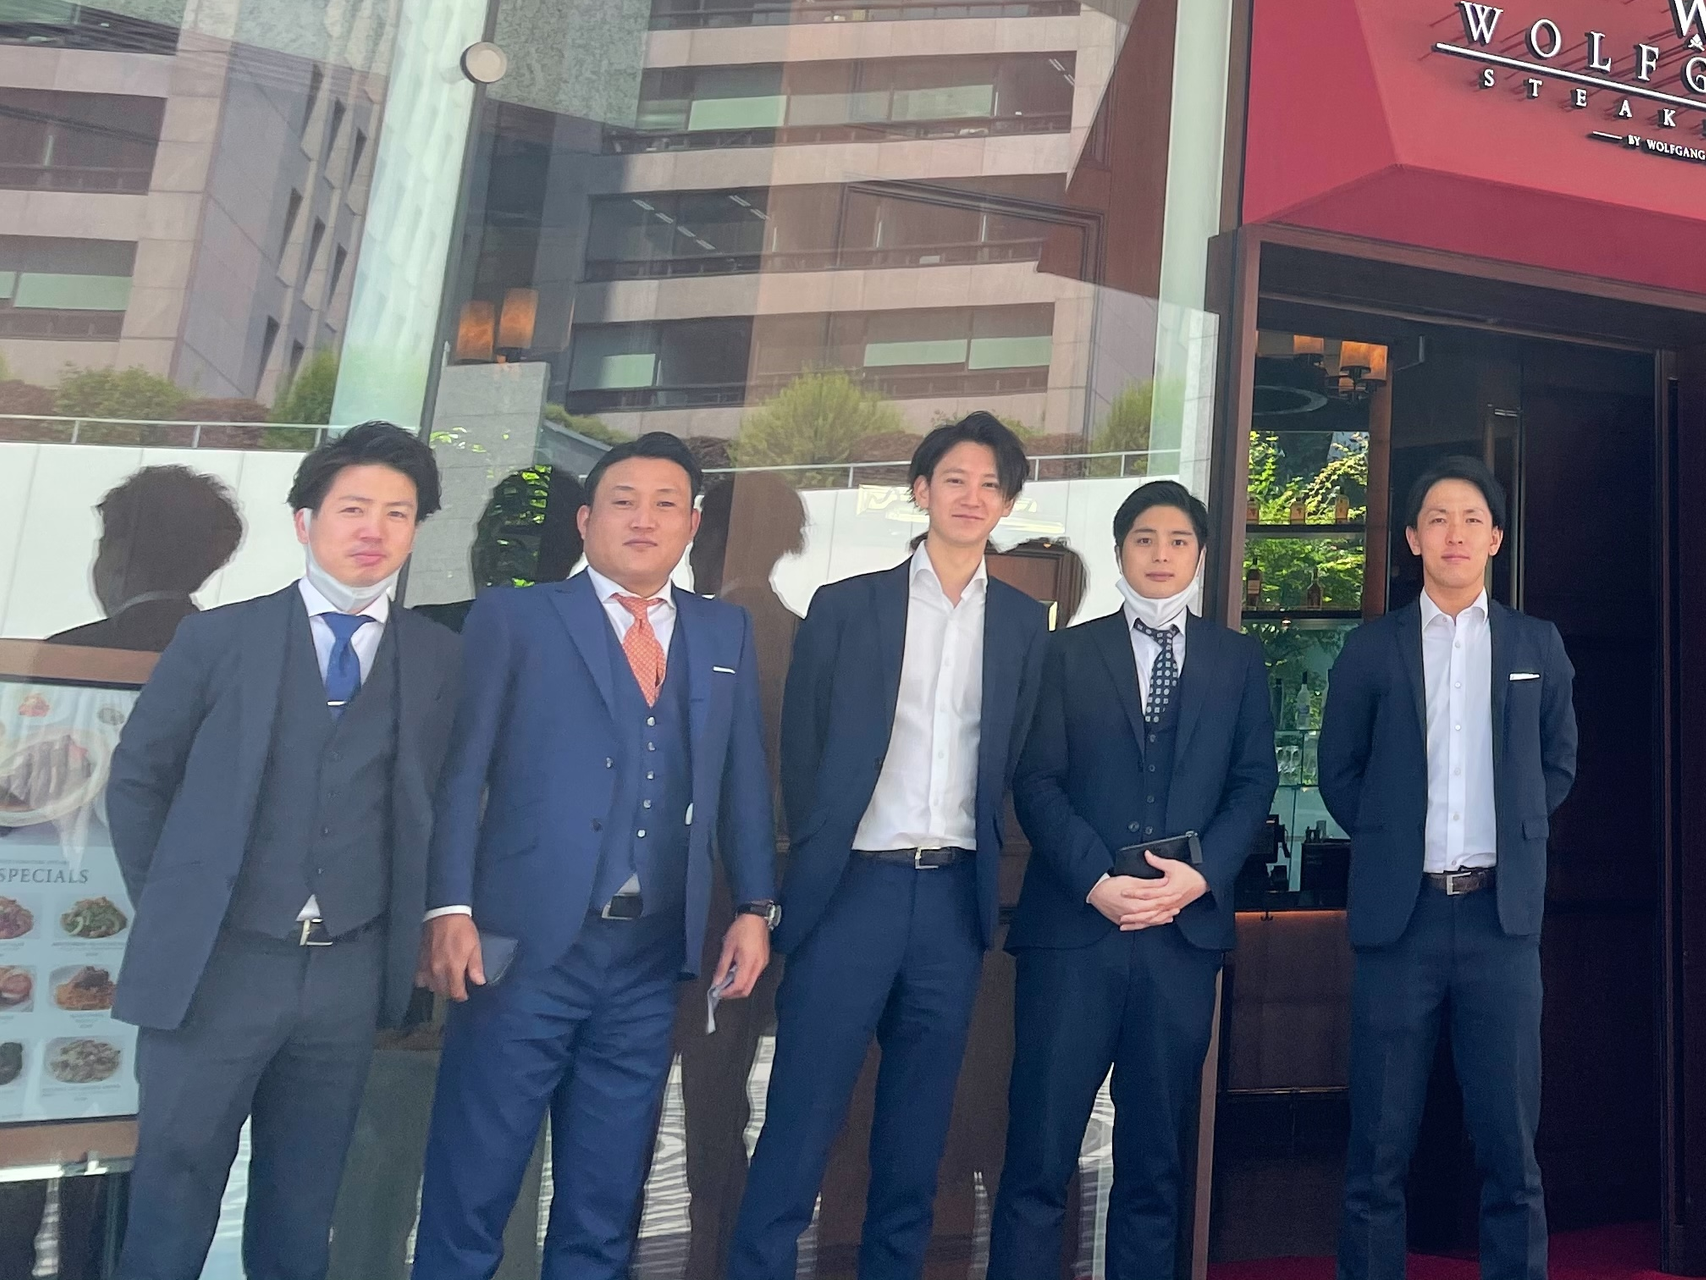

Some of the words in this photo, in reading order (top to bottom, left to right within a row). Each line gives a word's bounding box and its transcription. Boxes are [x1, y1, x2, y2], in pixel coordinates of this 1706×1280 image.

[1628, 134, 1641, 147] BY
[1646, 138, 1706, 161] WOLFGANG
[0, 867, 89, 884] SPECIALS
